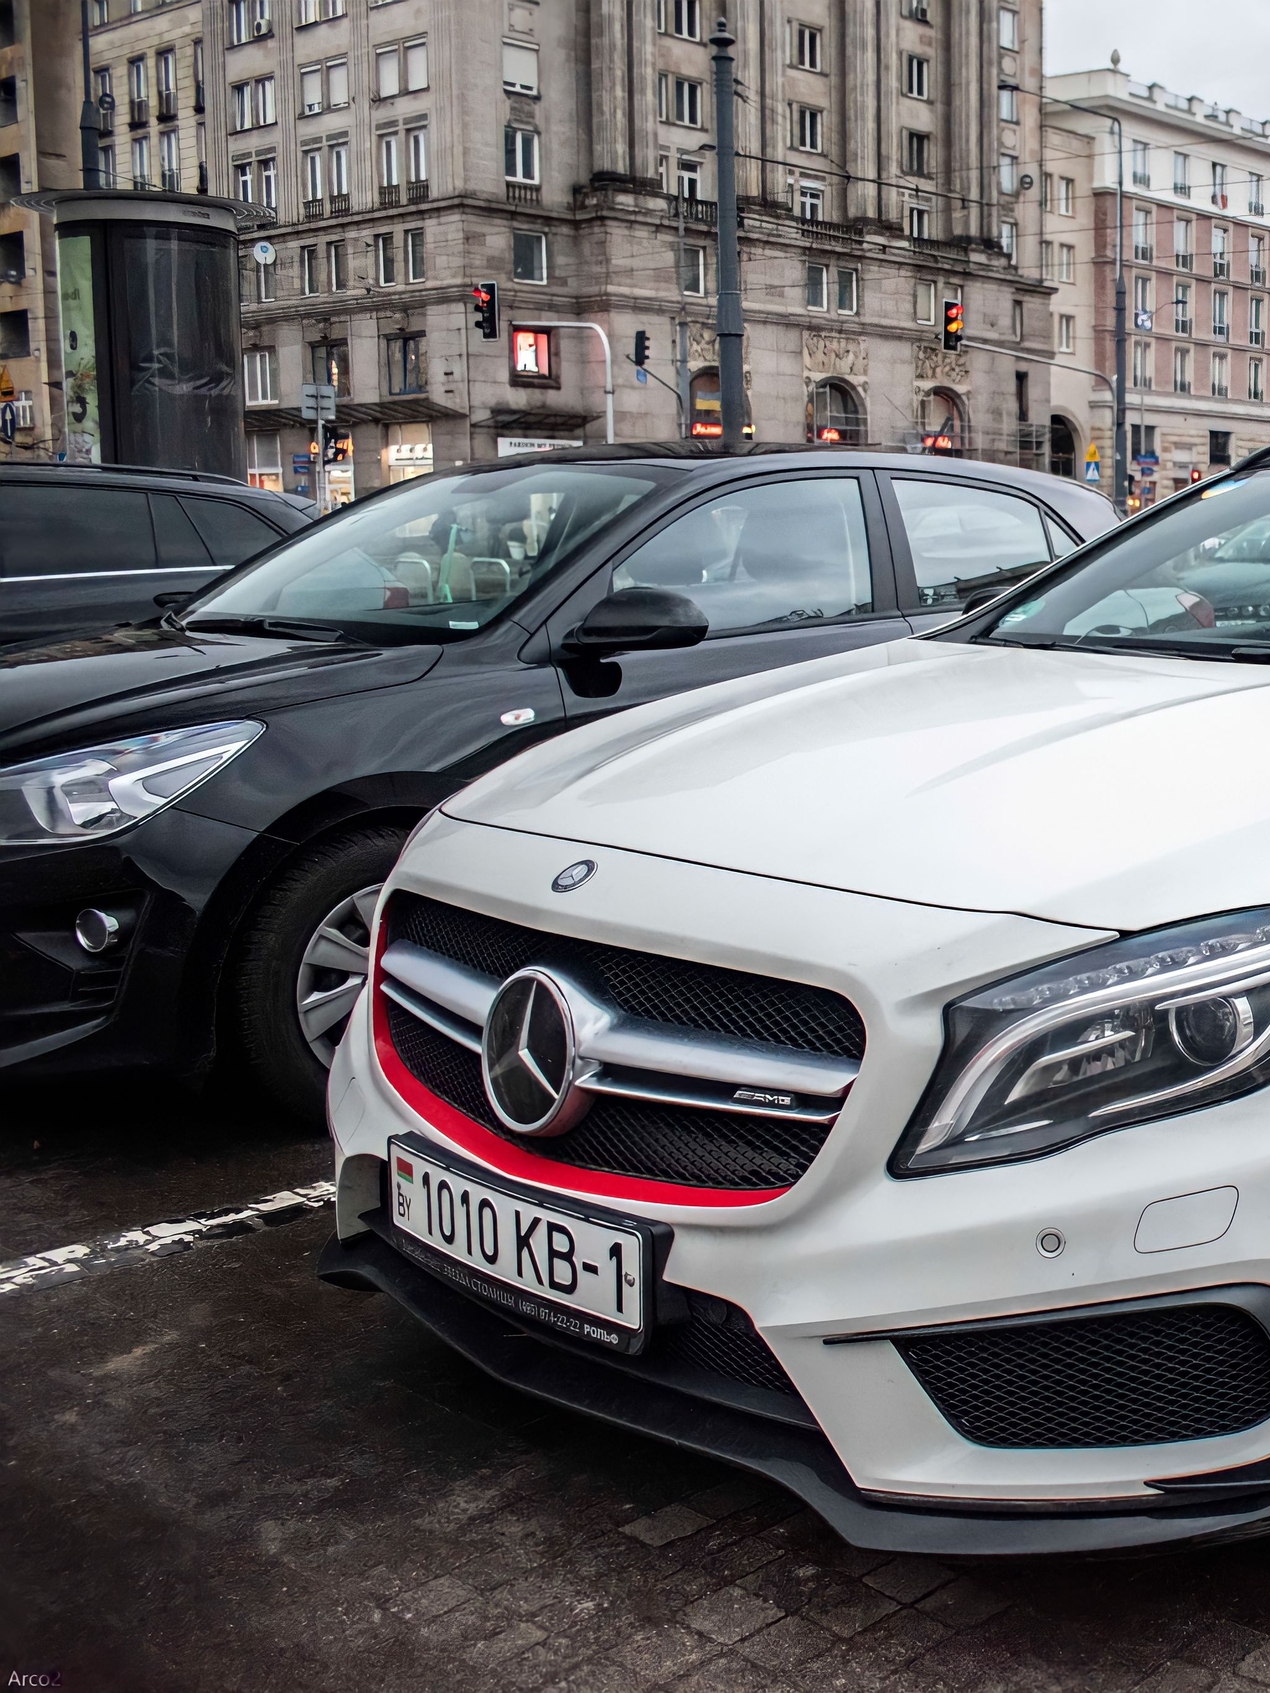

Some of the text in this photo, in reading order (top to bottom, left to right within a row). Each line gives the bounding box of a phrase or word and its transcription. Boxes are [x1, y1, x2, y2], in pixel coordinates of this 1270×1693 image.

[750, 1092, 791, 1106] AMG
[397, 1191, 412, 1221] BY
[422, 1171, 624, 1315] 1010 KB-1
